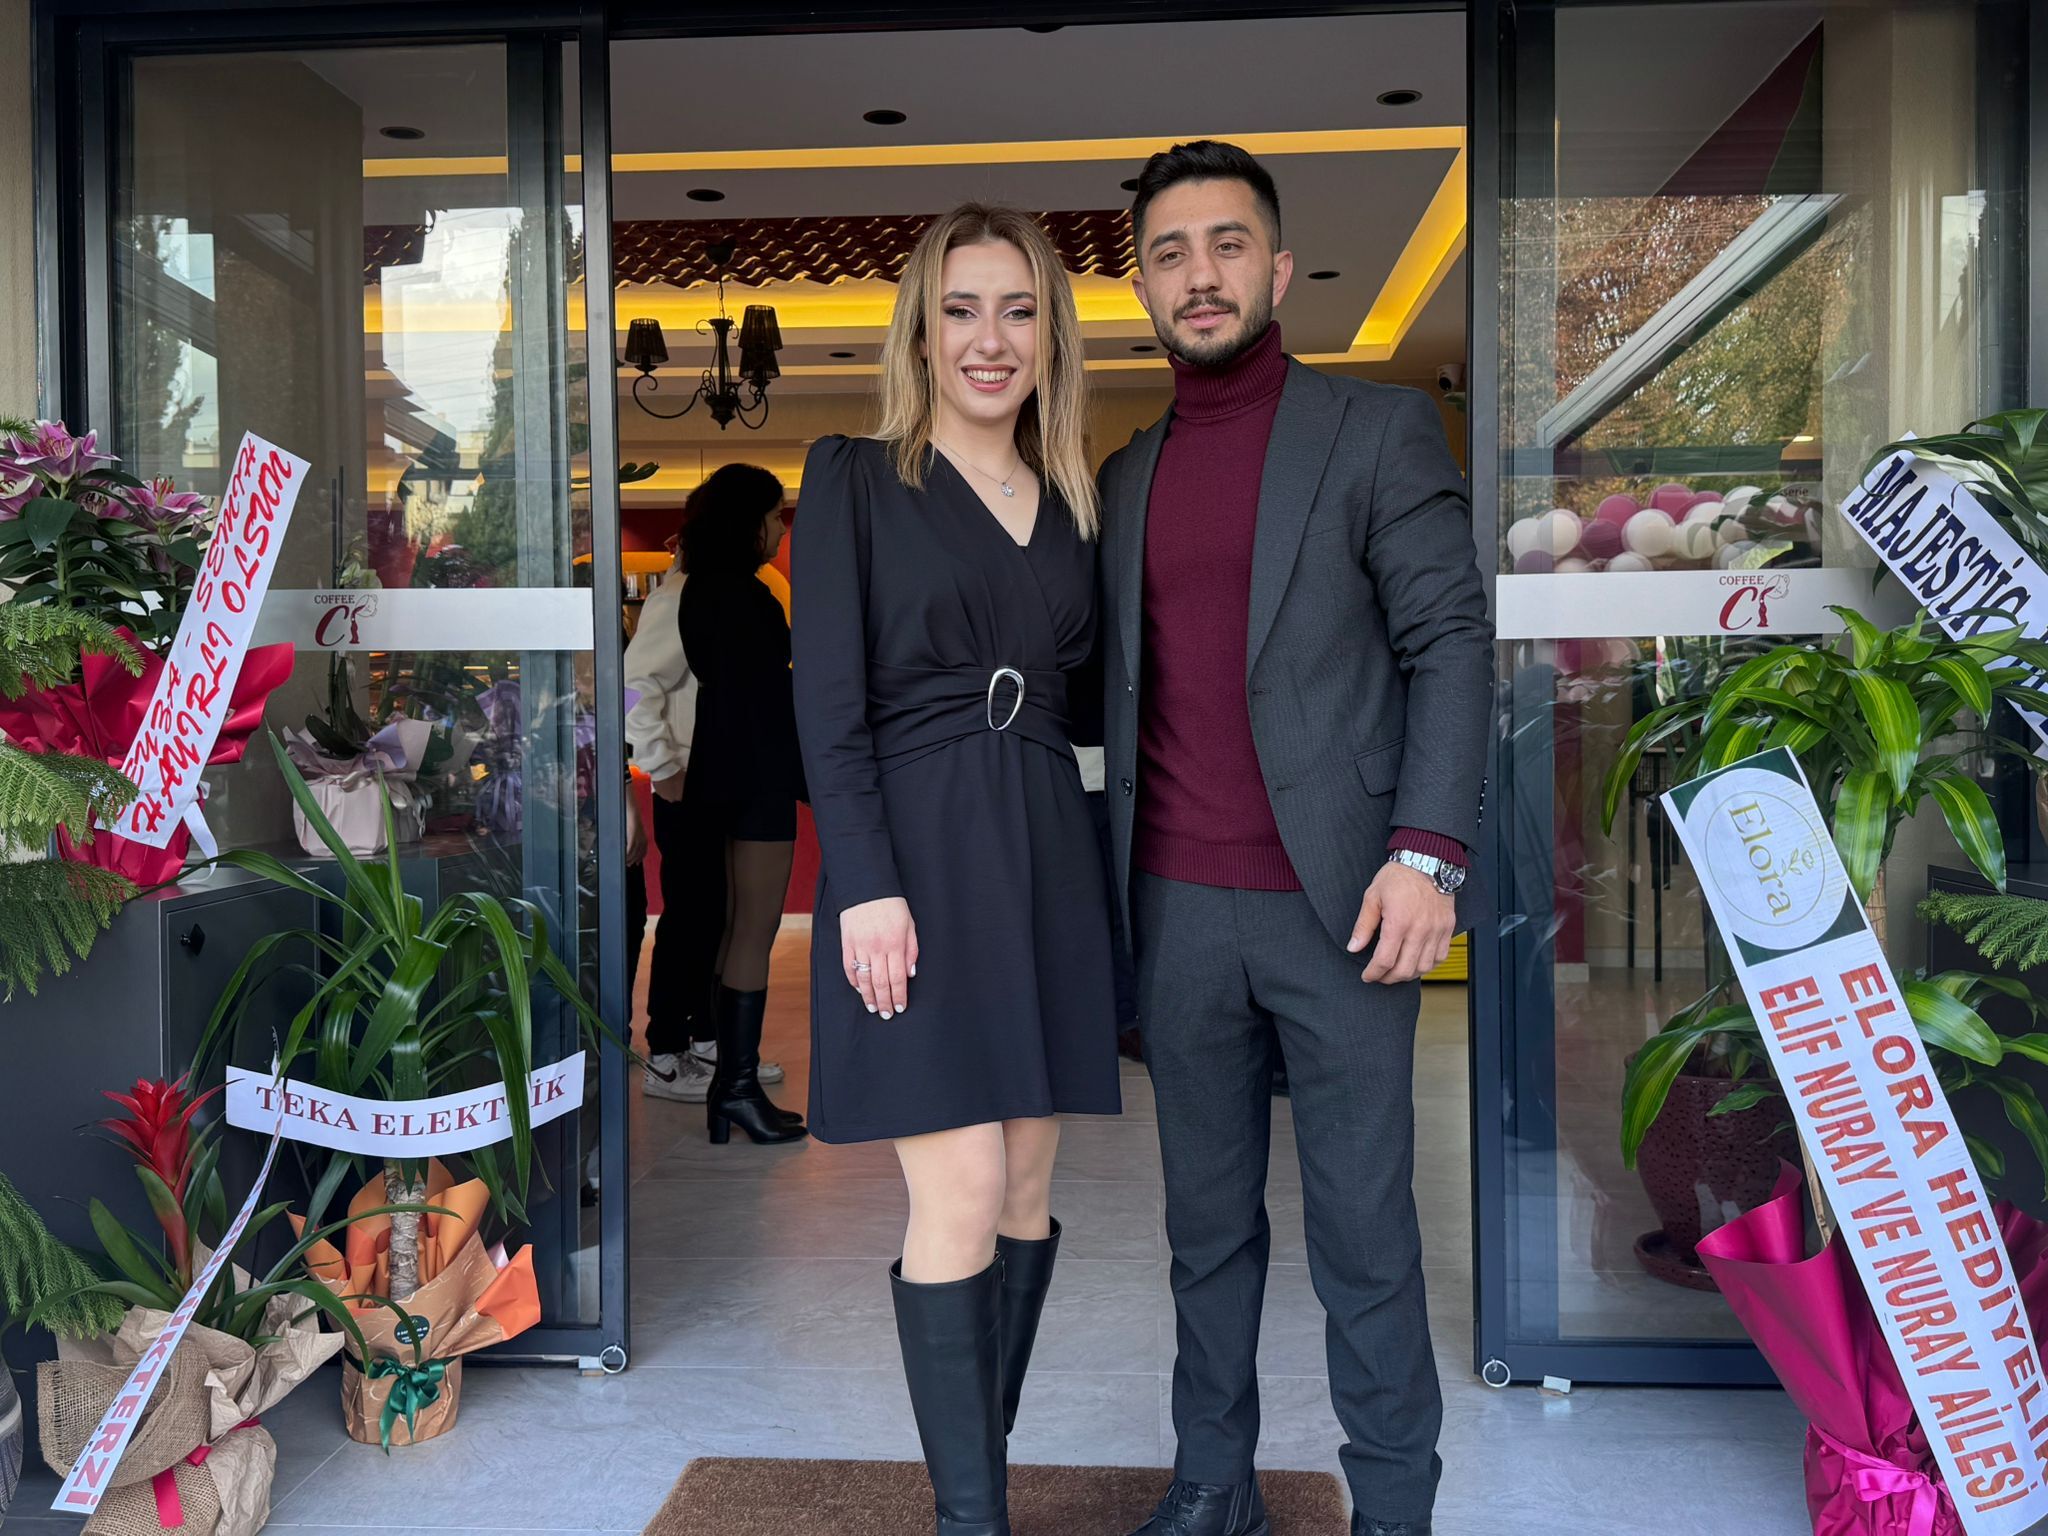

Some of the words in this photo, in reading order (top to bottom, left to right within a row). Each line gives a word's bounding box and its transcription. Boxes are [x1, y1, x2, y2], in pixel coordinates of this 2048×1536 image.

[314, 594, 355, 605] COFFEE
[1718, 575, 1765, 585] COFFEE
[131, 621, 233, 834] HAYIRLI
[222, 450, 292, 614] OLSUN
[106, 661, 182, 819] EYZA
[1727, 800, 1793, 918] Elora
[1759, 975, 1848, 1056] ELİF
[1839, 962, 1950, 1159] ELORA
[256, 1085, 359, 1132] TEKA
[371, 1073, 566, 1136] ELEKTİK
[1794, 1060, 1899, 1186] NURAY
[1850, 1189, 1923, 1249] VE
[1871, 1248, 1981, 1377] NURAY
[1927, 1388, 2039, 1513] AİLESİ
